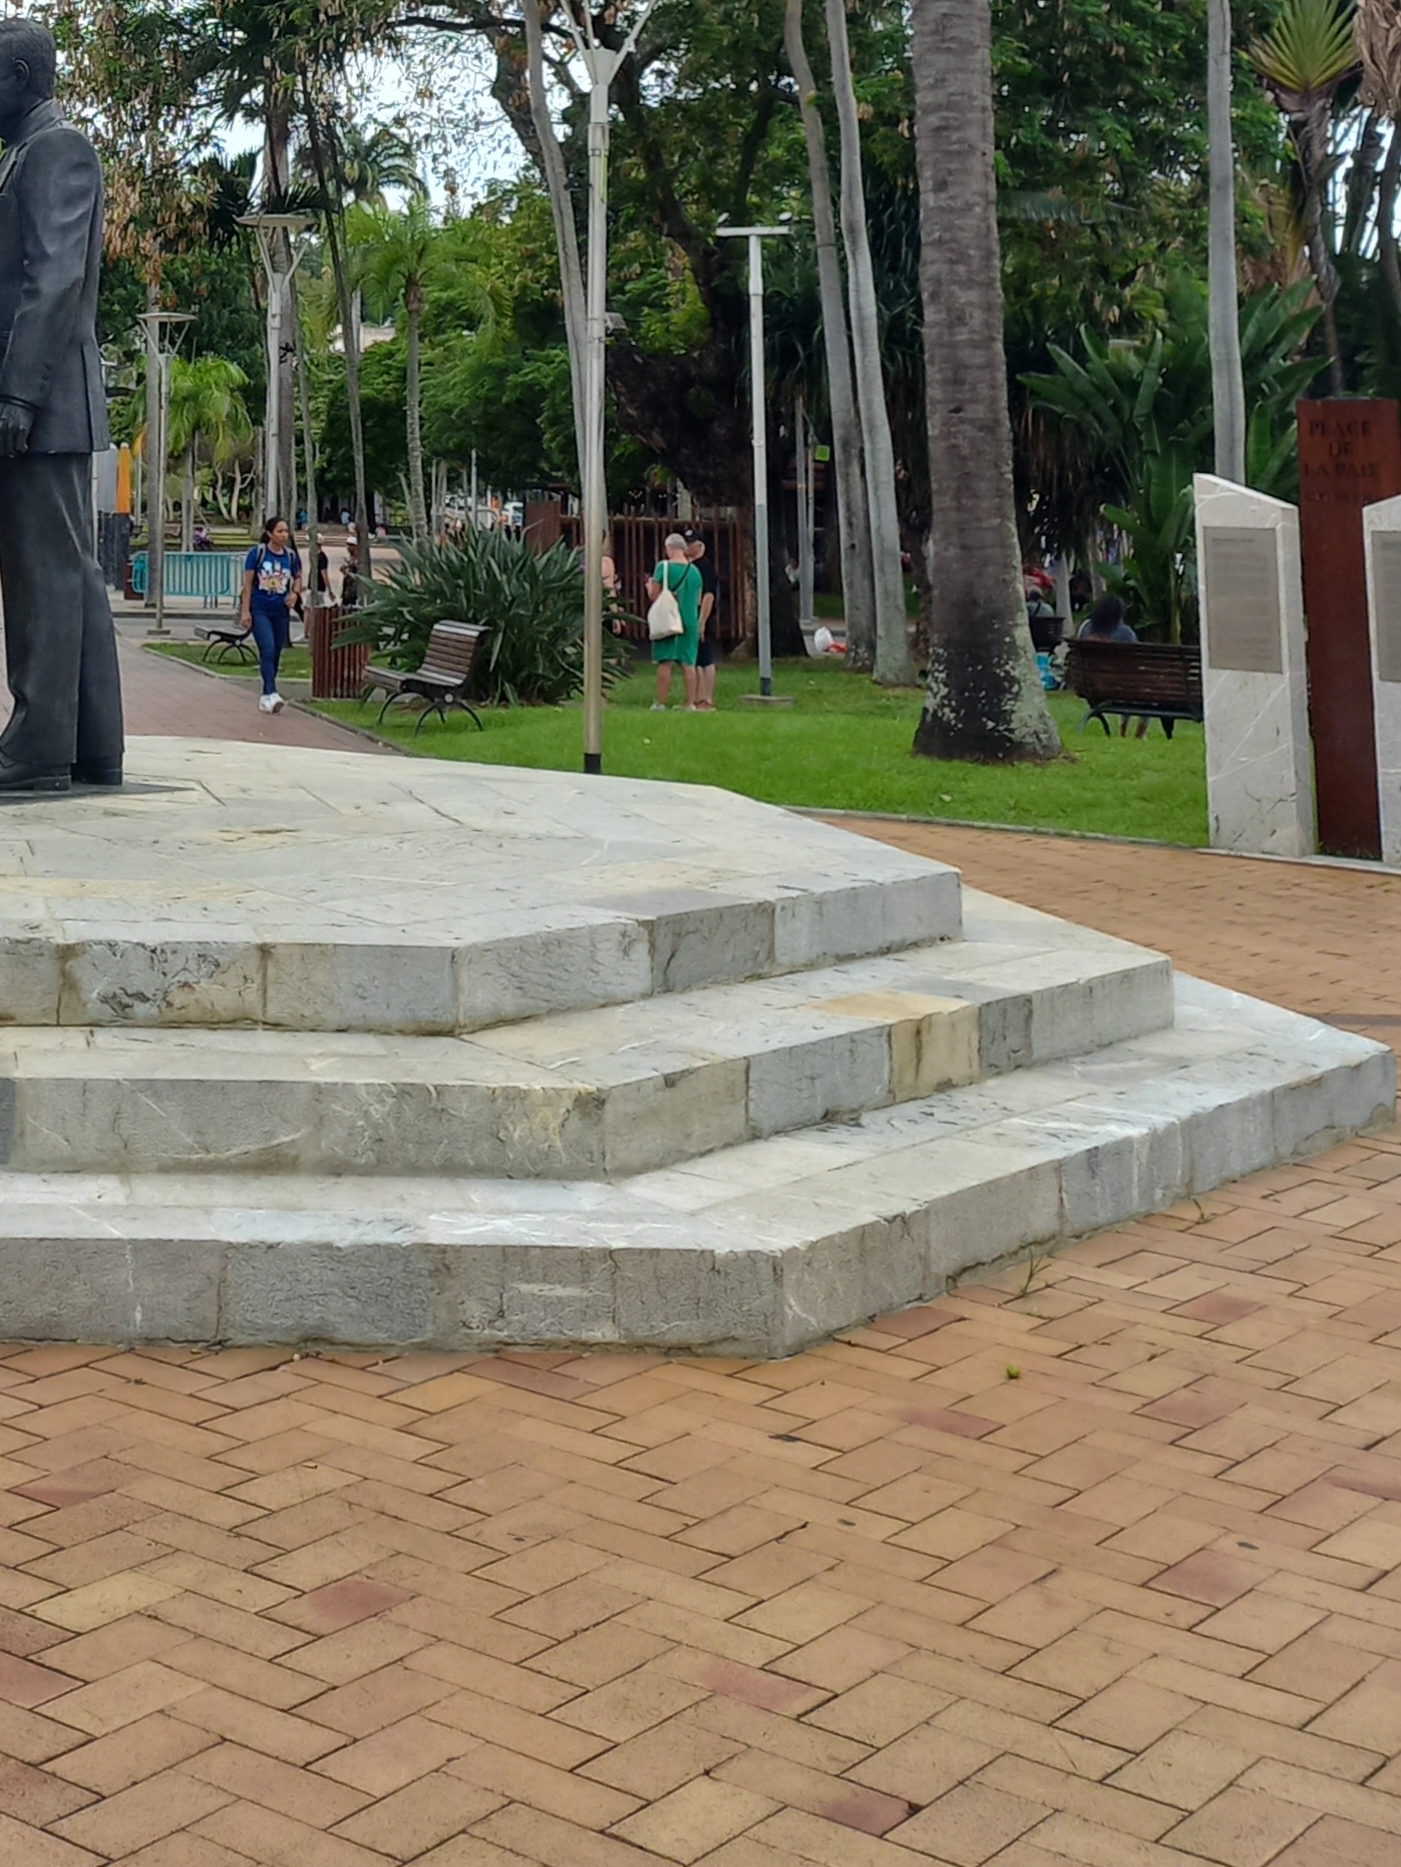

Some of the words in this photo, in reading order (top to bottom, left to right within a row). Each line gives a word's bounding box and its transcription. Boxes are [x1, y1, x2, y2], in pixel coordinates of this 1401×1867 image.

[1308, 419, 1371, 438] PLACE
[1328, 440, 1353, 459] DE
[1303, 462, 1330, 479] LA
[1334, 462, 1379, 479] PAIX
